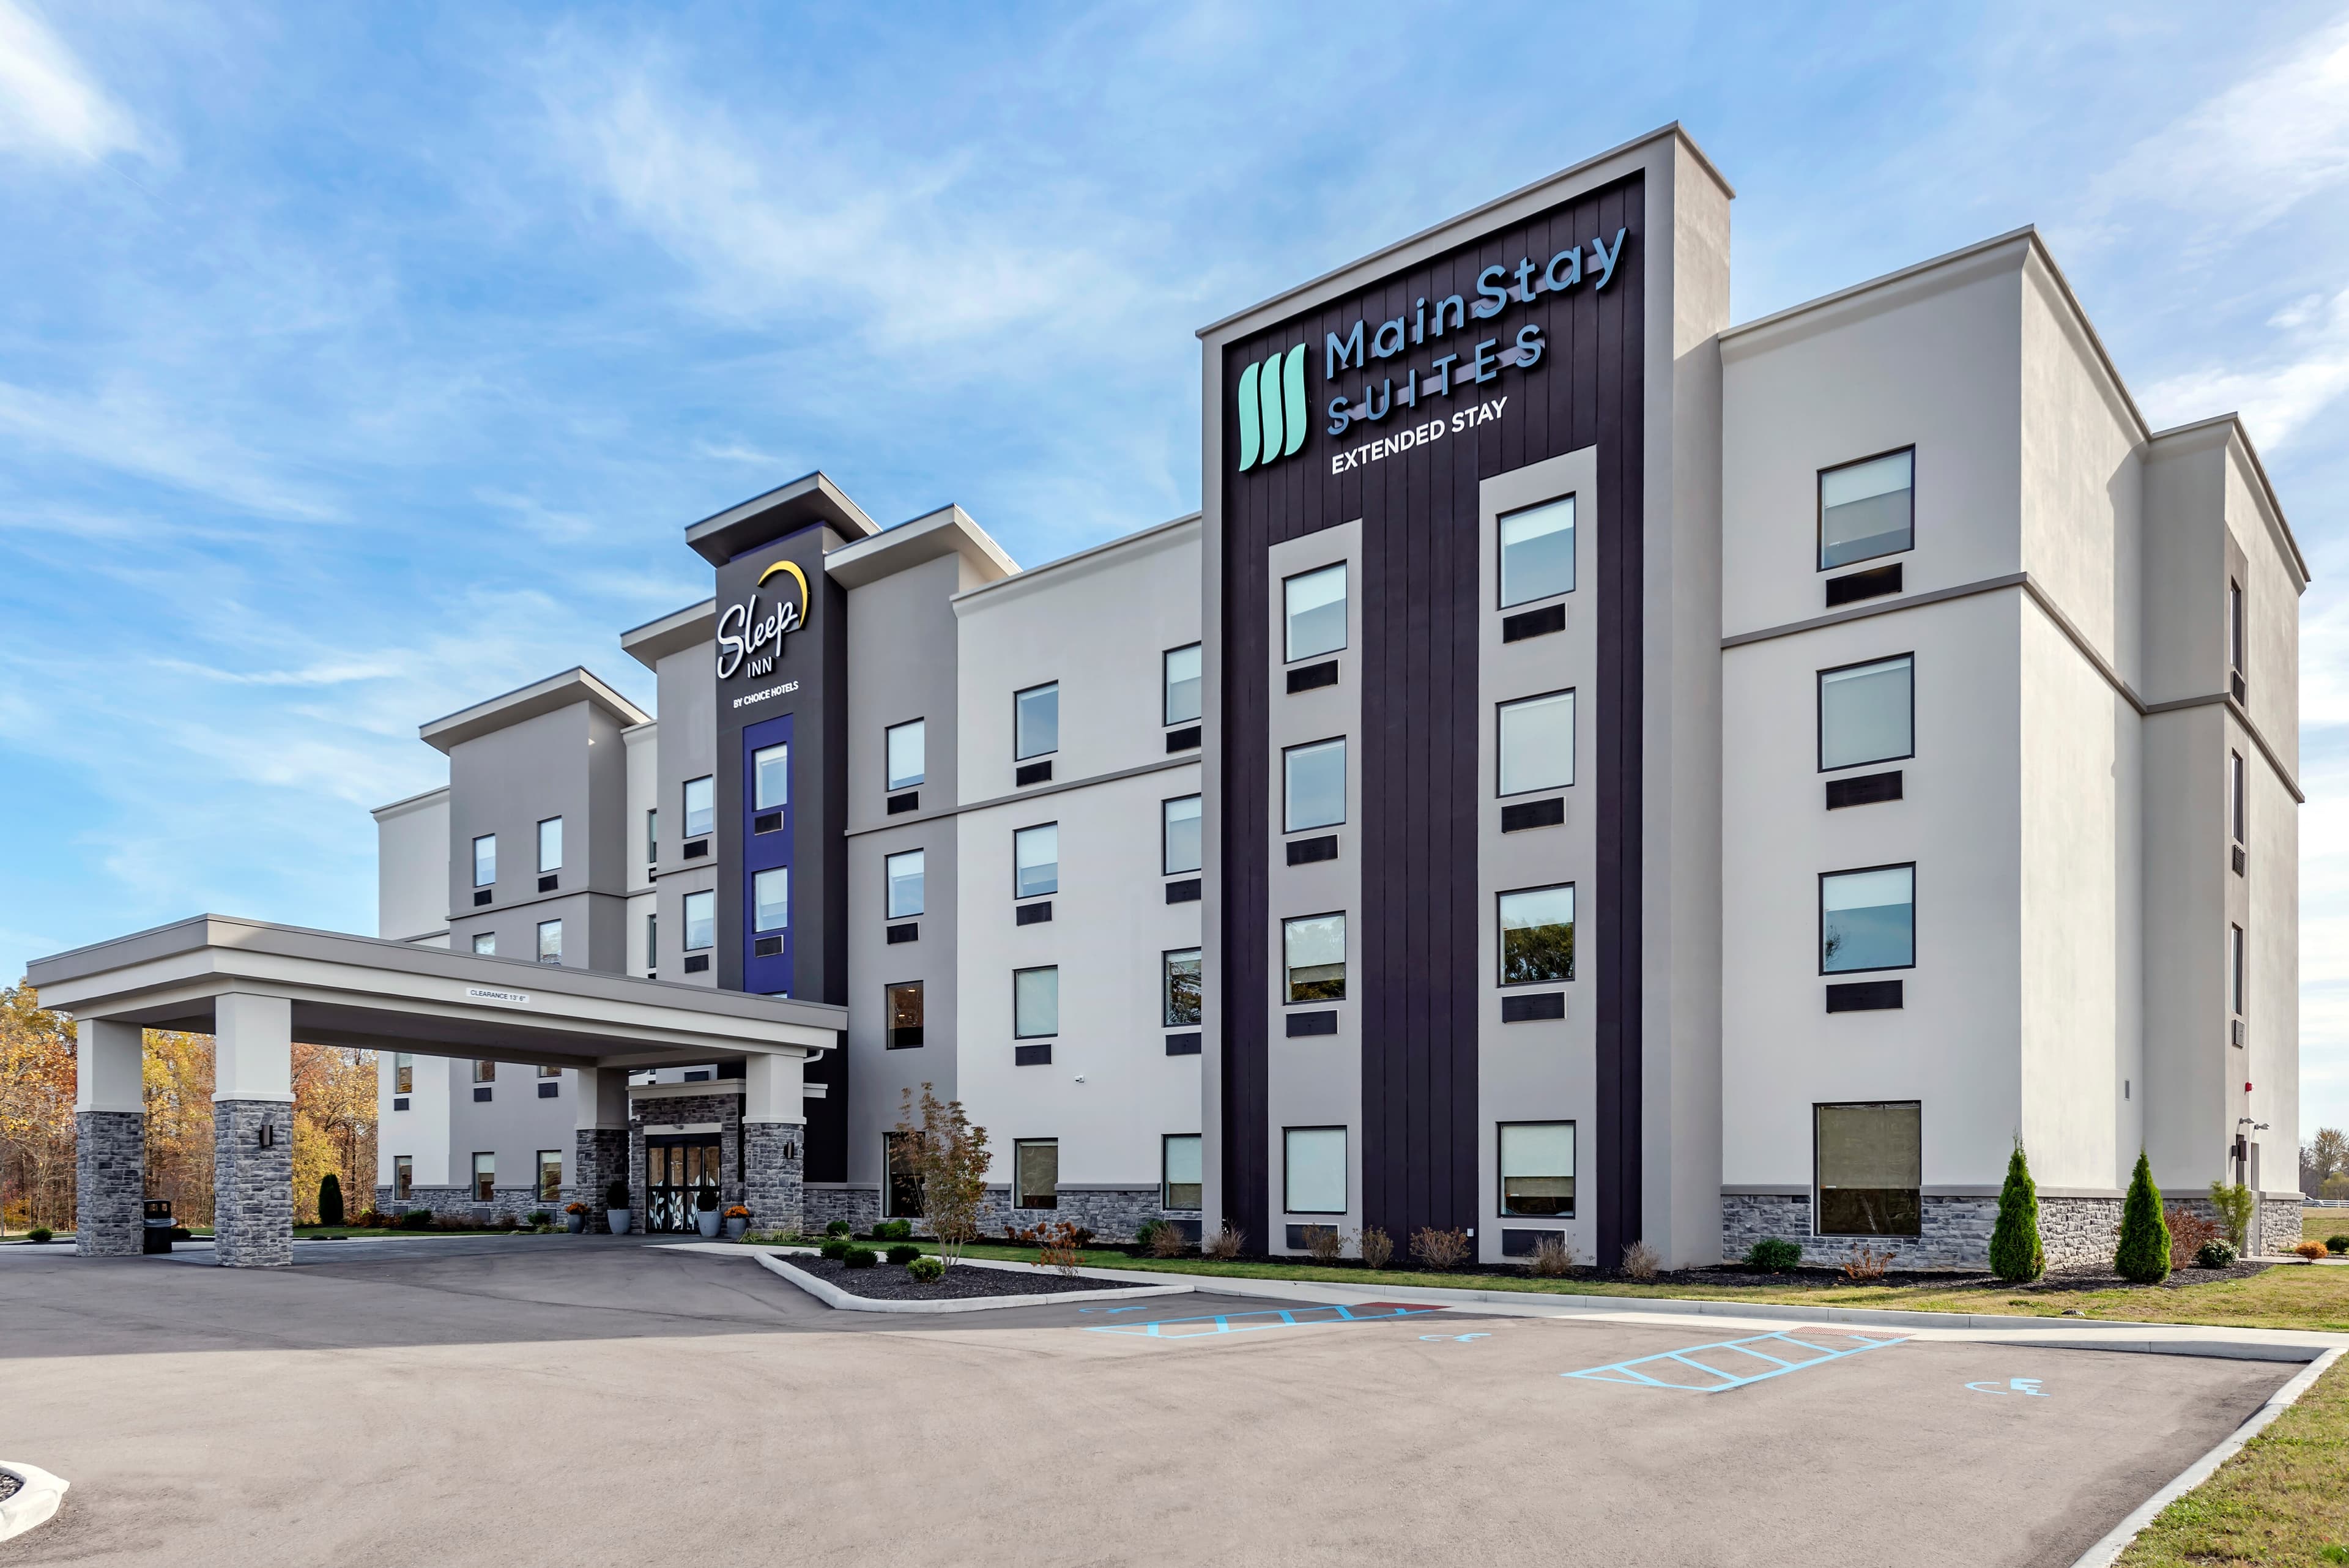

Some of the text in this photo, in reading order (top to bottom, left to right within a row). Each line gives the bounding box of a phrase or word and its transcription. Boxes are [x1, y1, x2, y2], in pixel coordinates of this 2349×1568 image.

[1326, 227, 1630, 380] MainStay
[1326, 324, 1545, 436] SUITES
[1331, 396, 1508, 475] EXTENDED STAY
[717, 593, 798, 679] Sleep
[747, 656, 772, 678] INN
[733, 681, 799, 708] BY CHOICE HOTELS
[470, 989, 508, 1000] CLEARANCE
